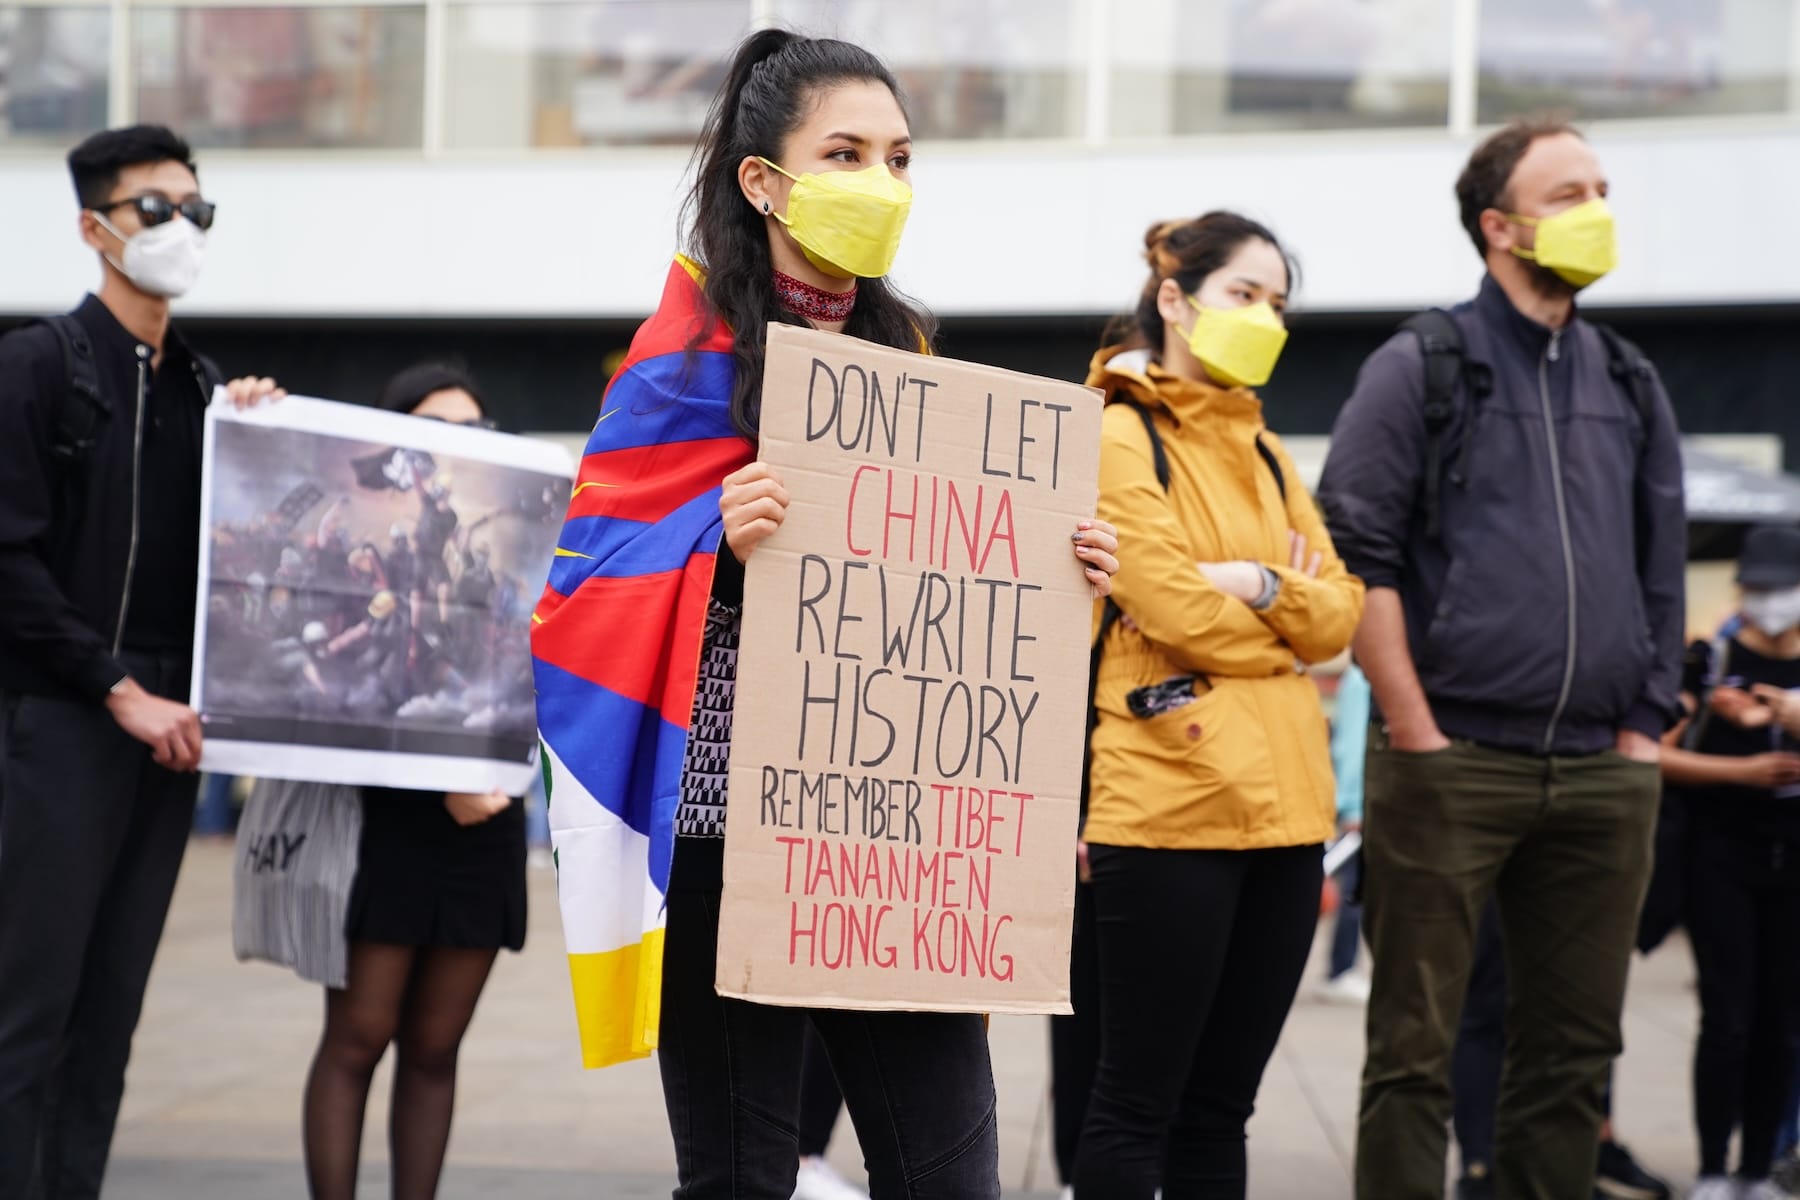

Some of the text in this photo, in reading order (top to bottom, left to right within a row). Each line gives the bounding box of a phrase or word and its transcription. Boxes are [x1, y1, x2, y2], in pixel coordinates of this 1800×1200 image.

[806, 358, 1072, 490] DON'T LET
[846, 465, 1019, 578] CHINA
[796, 554, 1042, 682] REWRITE
[798, 660, 1040, 784] HISTORY
[243, 832, 306, 873] HAY
[760, 765, 1034, 857] REMEMBER TIBET
[775, 836, 991, 912] TIANANMEN
[789, 901, 1014, 982] HONG KONG
